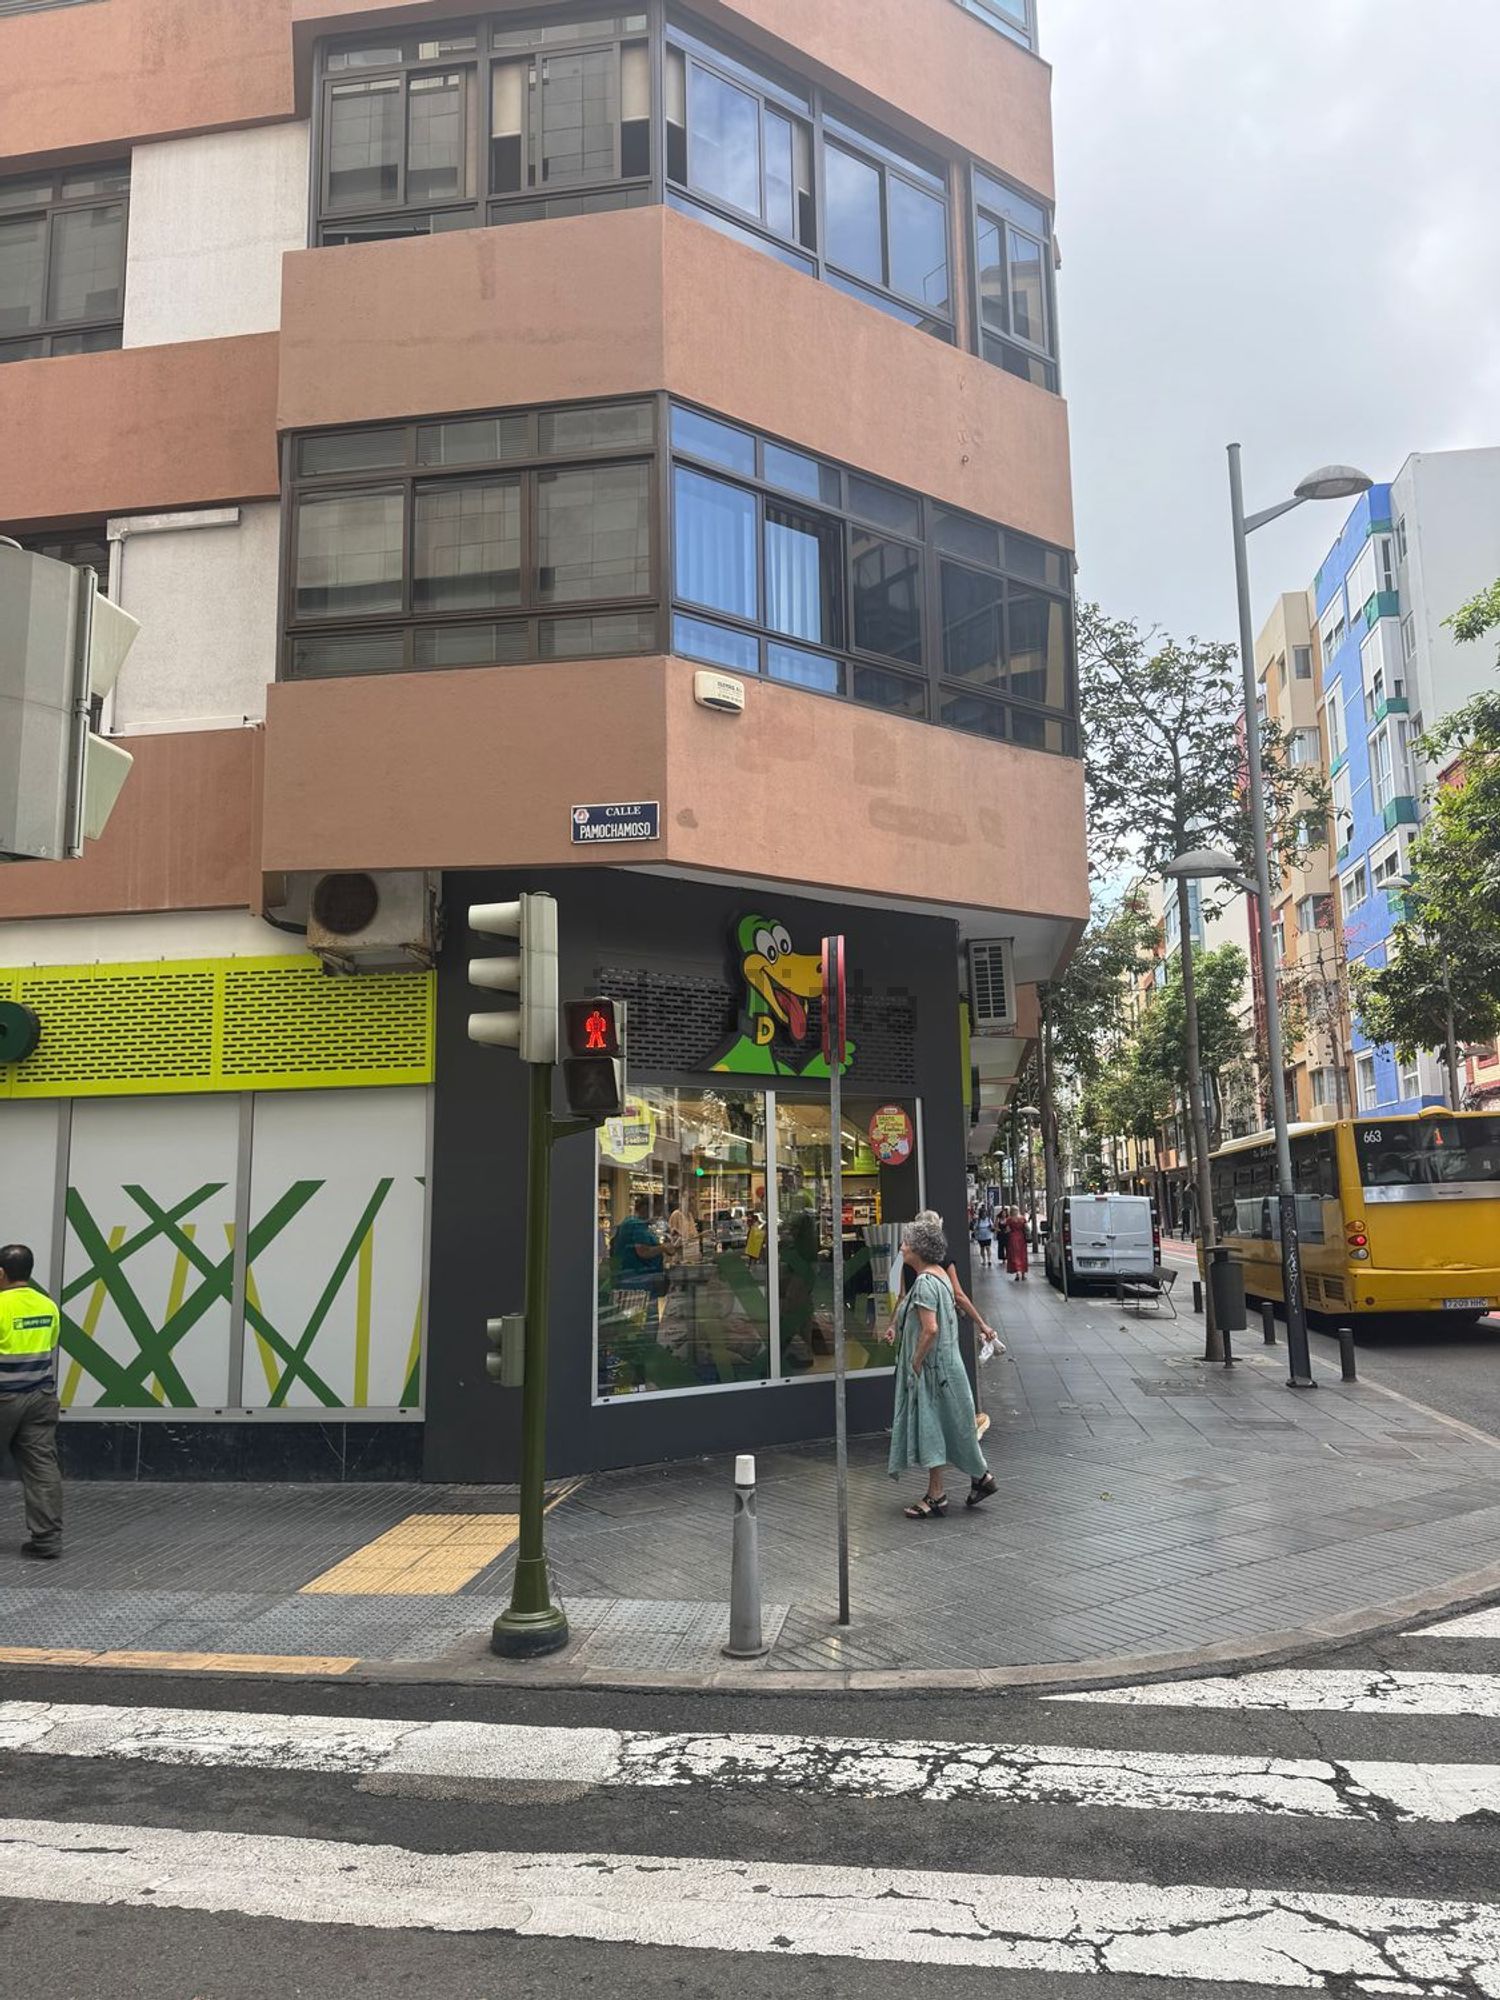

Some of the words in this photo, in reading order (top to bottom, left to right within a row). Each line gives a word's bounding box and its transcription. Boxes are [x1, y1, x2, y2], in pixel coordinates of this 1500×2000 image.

[605, 806, 641, 817] CALLE
[580, 822, 651, 839] PAMOCHAMOSO
[756, 1015, 775, 1046] D
[1363, 1130, 1382, 1143] 663
